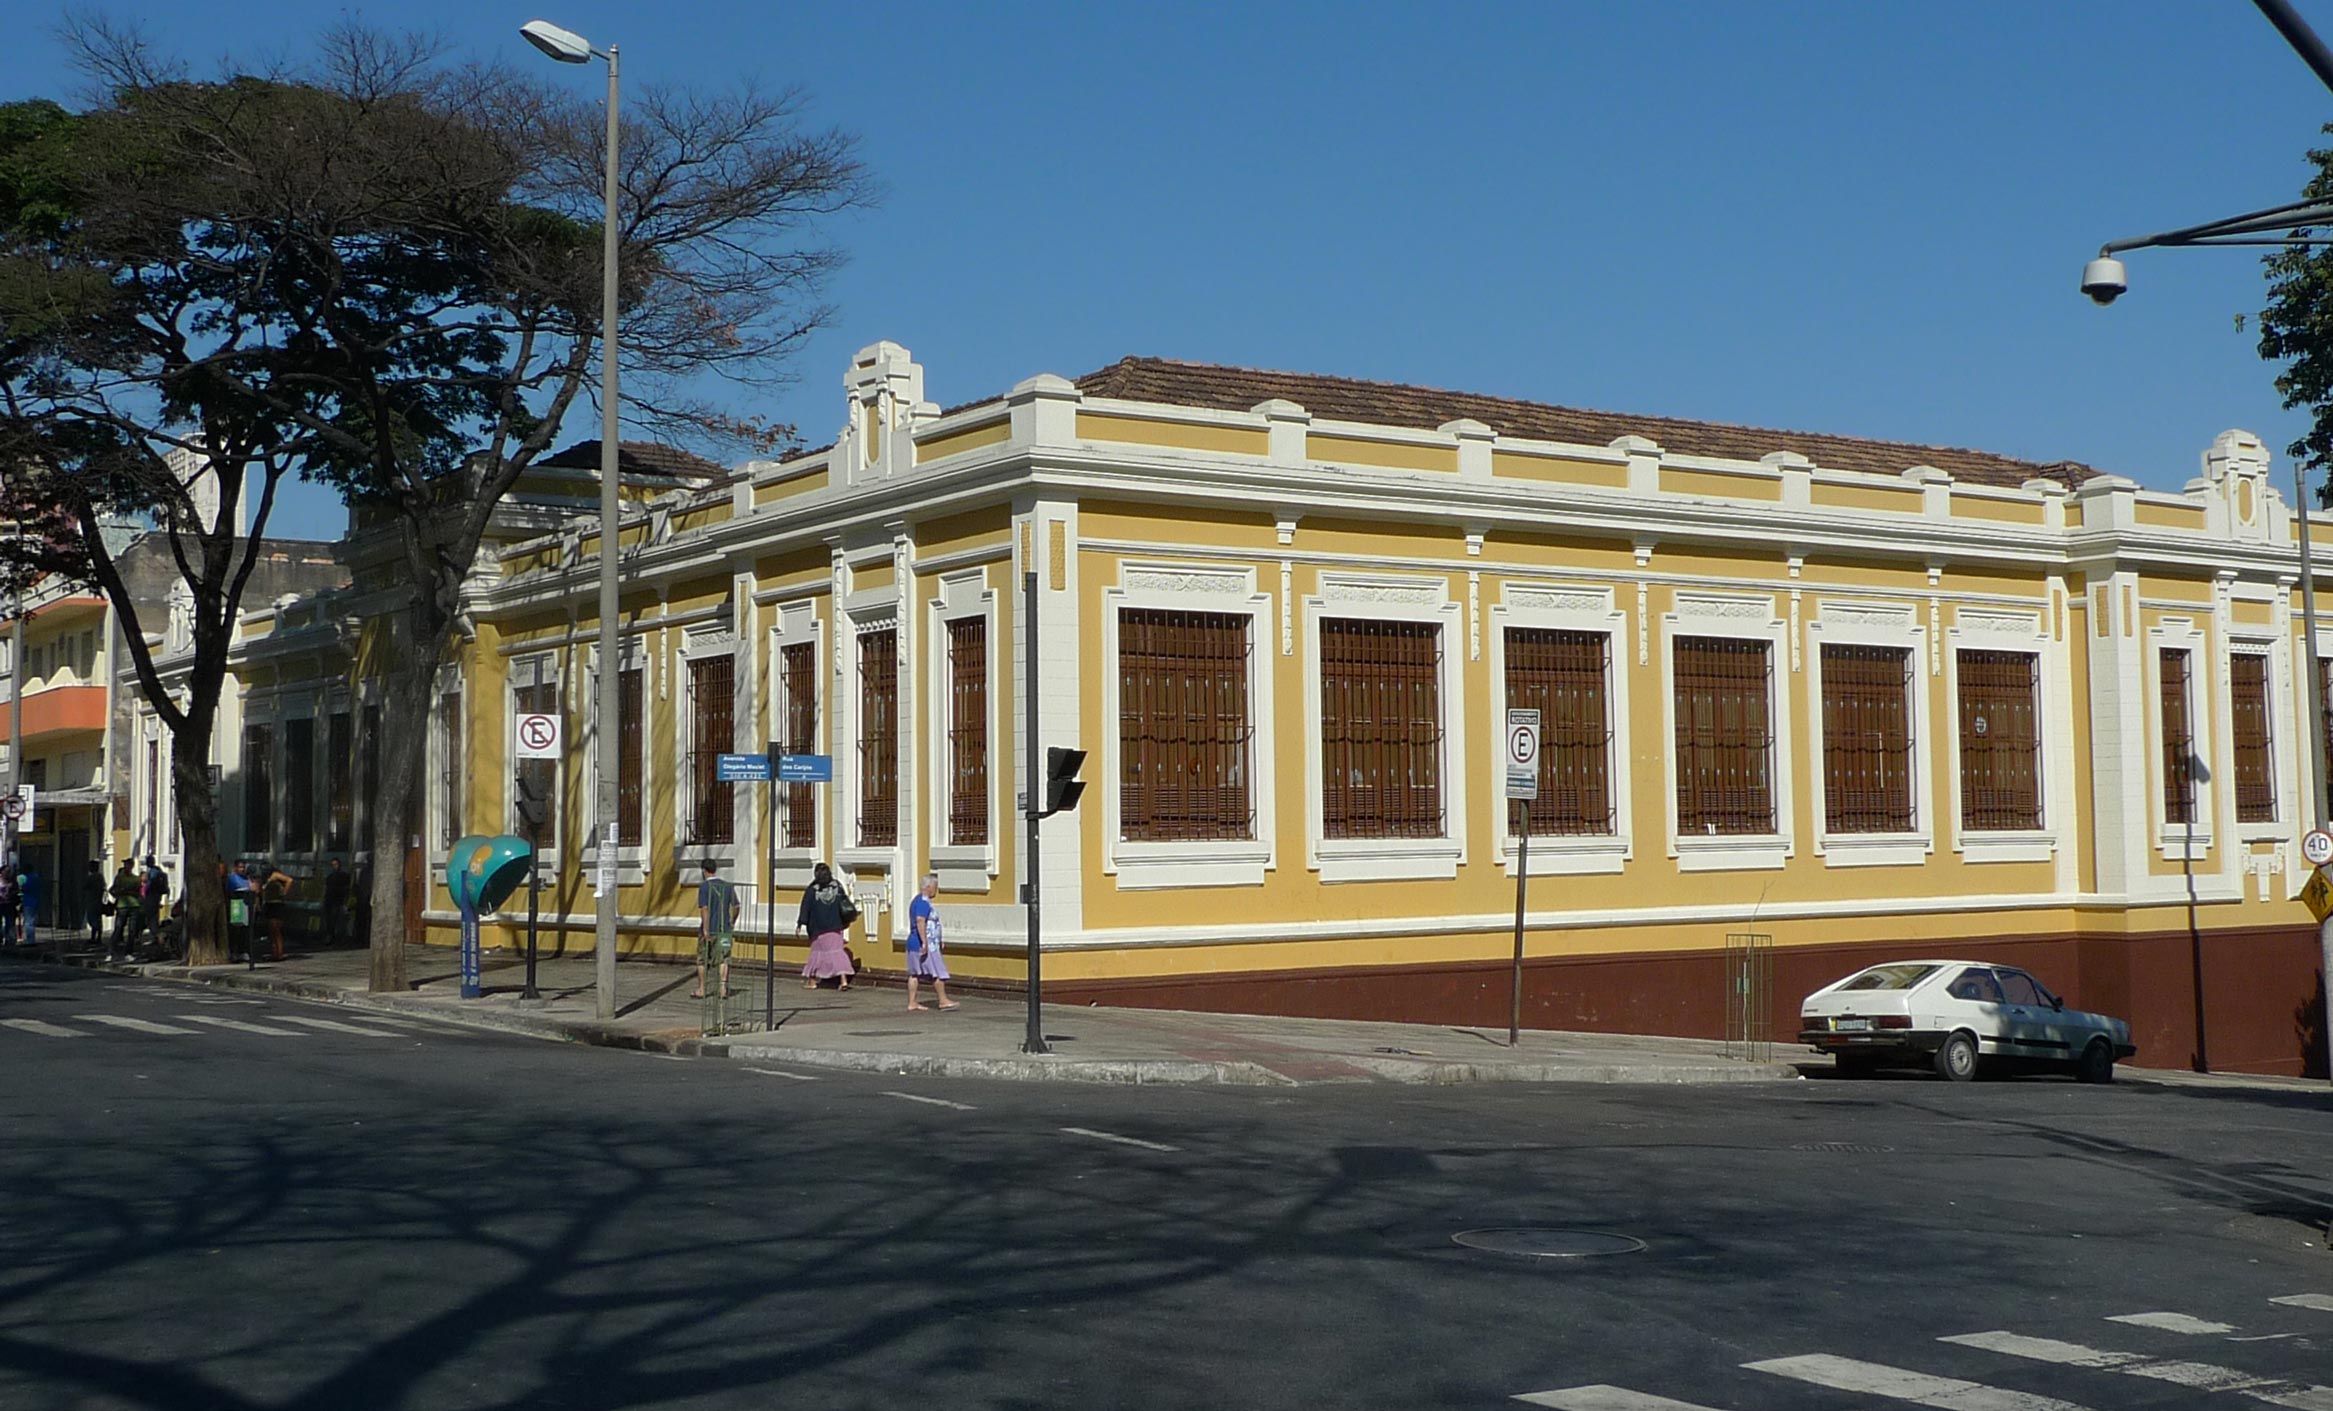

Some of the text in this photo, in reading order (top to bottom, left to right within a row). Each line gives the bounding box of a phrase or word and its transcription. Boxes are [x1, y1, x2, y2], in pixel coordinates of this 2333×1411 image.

[532, 722, 545, 744] E
[1518, 733, 1528, 757] E
[2308, 837, 2328, 852] 40
